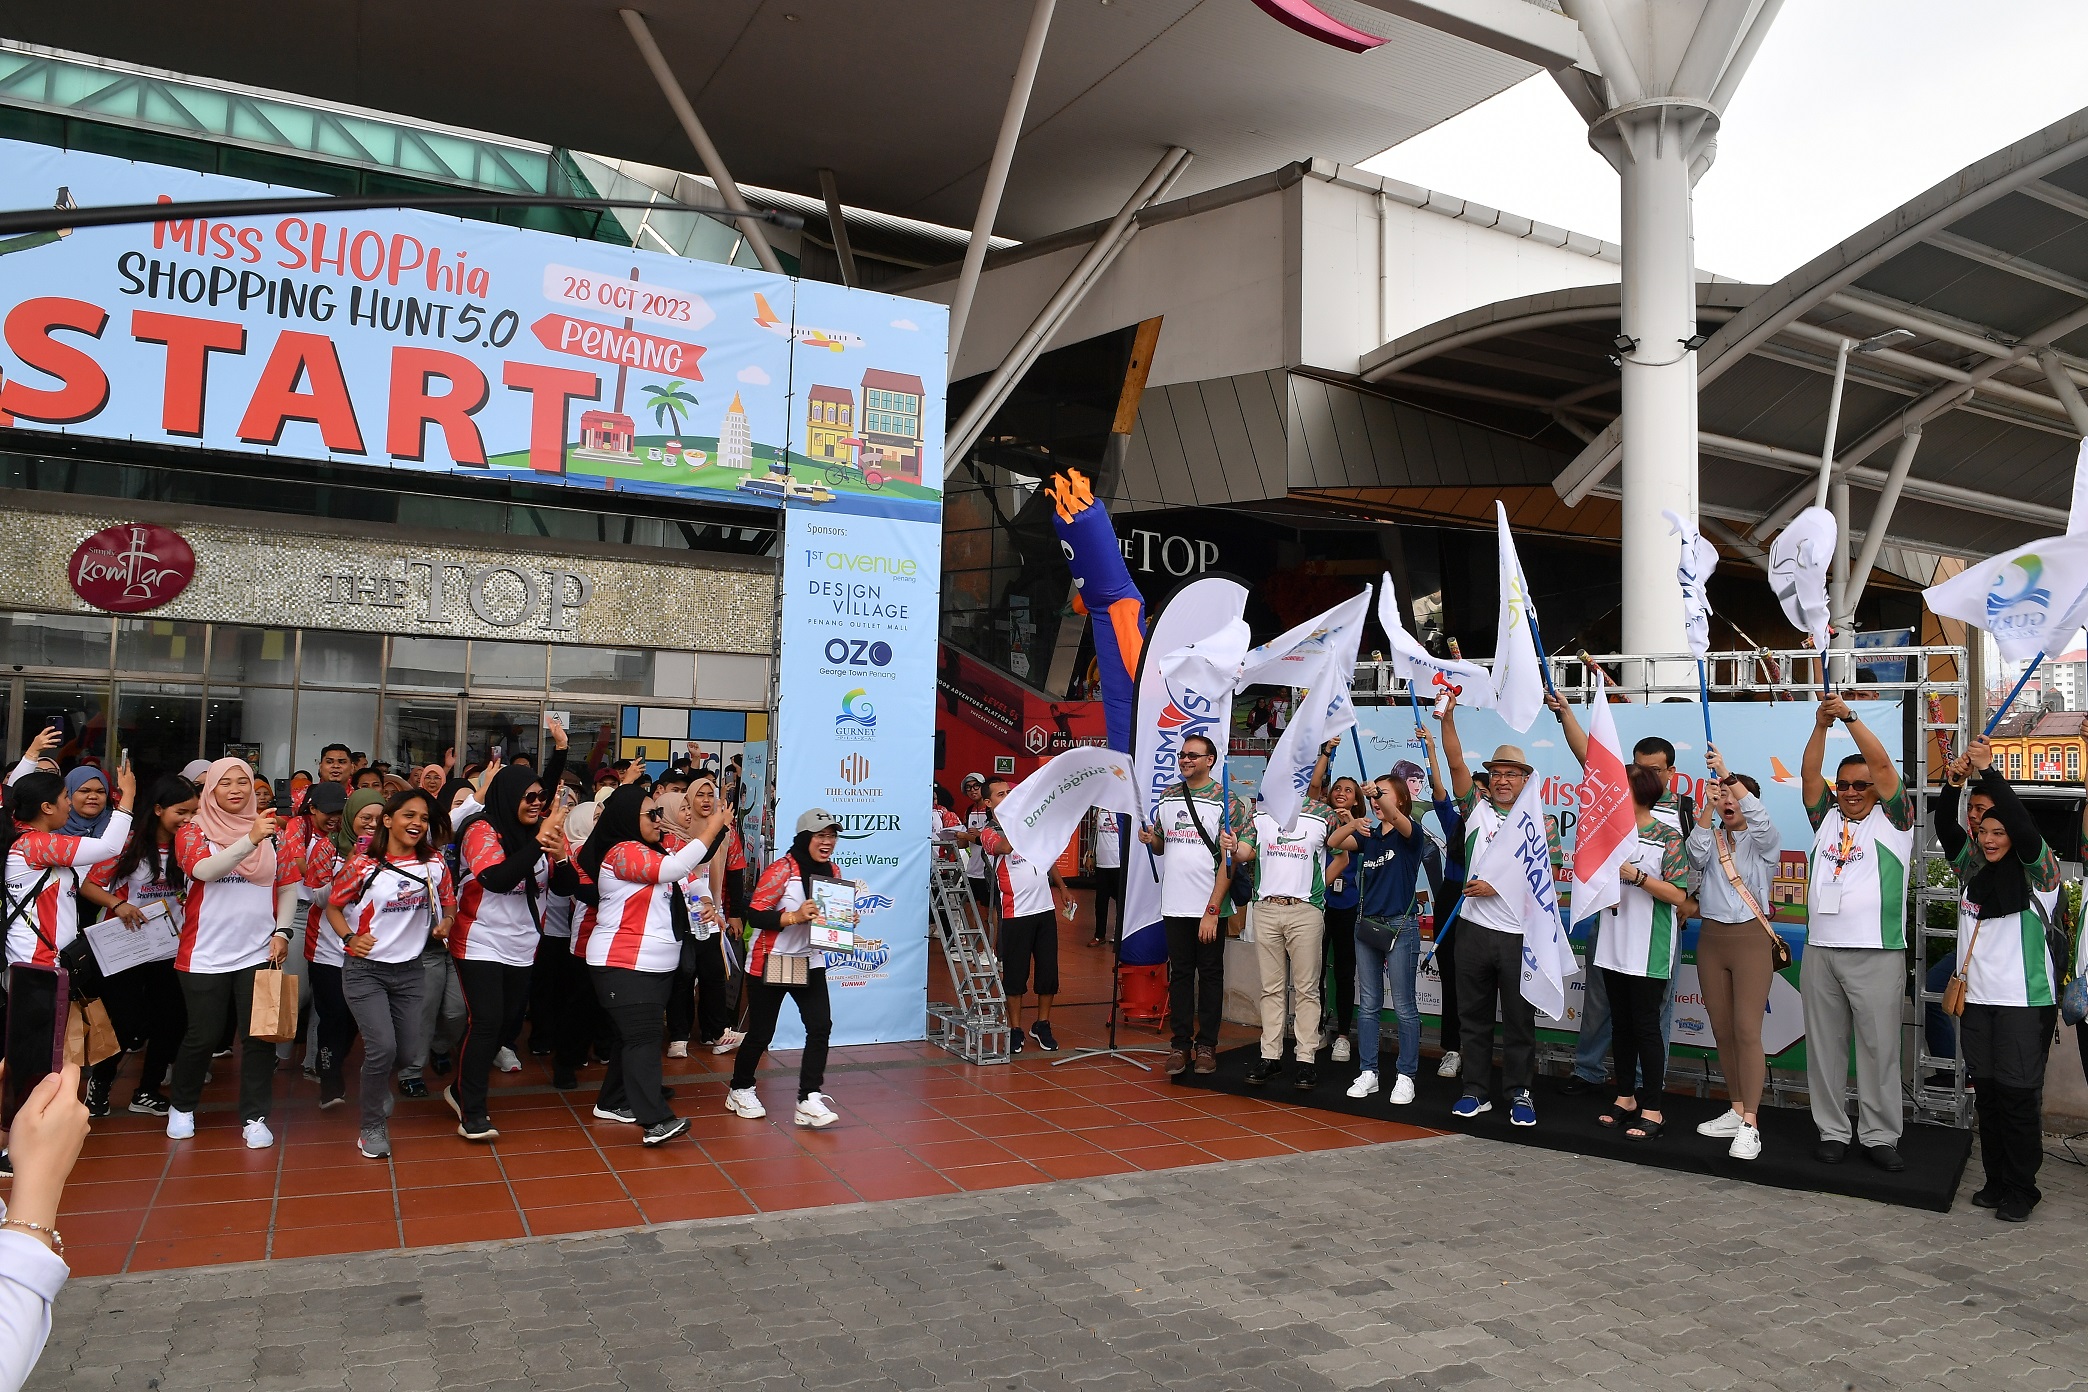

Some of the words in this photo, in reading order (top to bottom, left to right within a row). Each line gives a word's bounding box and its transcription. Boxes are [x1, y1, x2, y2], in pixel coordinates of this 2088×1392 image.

[117, 251, 338, 323] SHOPPING
[562, 276, 591, 301] 28
[597, 283, 639, 312] OCT
[642, 292, 692, 322] 2023
[0, 295, 602, 478] START
[806, 522, 848, 537] Sponsors:
[88, 546, 117, 558] Simply
[1131, 528, 1220, 577] TOP
[825, 552, 917, 577] avenue
[892, 574, 917, 584] penang
[321, 573, 410, 608] THE
[404, 558, 593, 632] TOP
[809, 580, 881, 600] DESIGN
[833, 599, 909, 619] VILLAGE
[807, 618, 844, 627] PENANG
[849, 621, 881, 630] OUTLET
[886, 623, 908, 632] MALL
[824, 637, 893, 667] OZO
[819, 667, 847, 678] George
[848, 669, 868, 678] Town
[869, 670, 896, 680] Penang
[951, 687, 984, 710] ADVENTURE
[983, 706, 1015, 728] PLATFORM
[983, 694, 1008, 713] LEVEL
[835, 727, 876, 738] GURNEY
[825, 787, 843, 796] THE
[844, 788, 883, 797] GRANITE
[833, 814, 901, 831] RITZER
[865, 855, 899, 867] Wang
[827, 929, 839, 943] 39
[841, 980, 867, 988] SUNWAY
